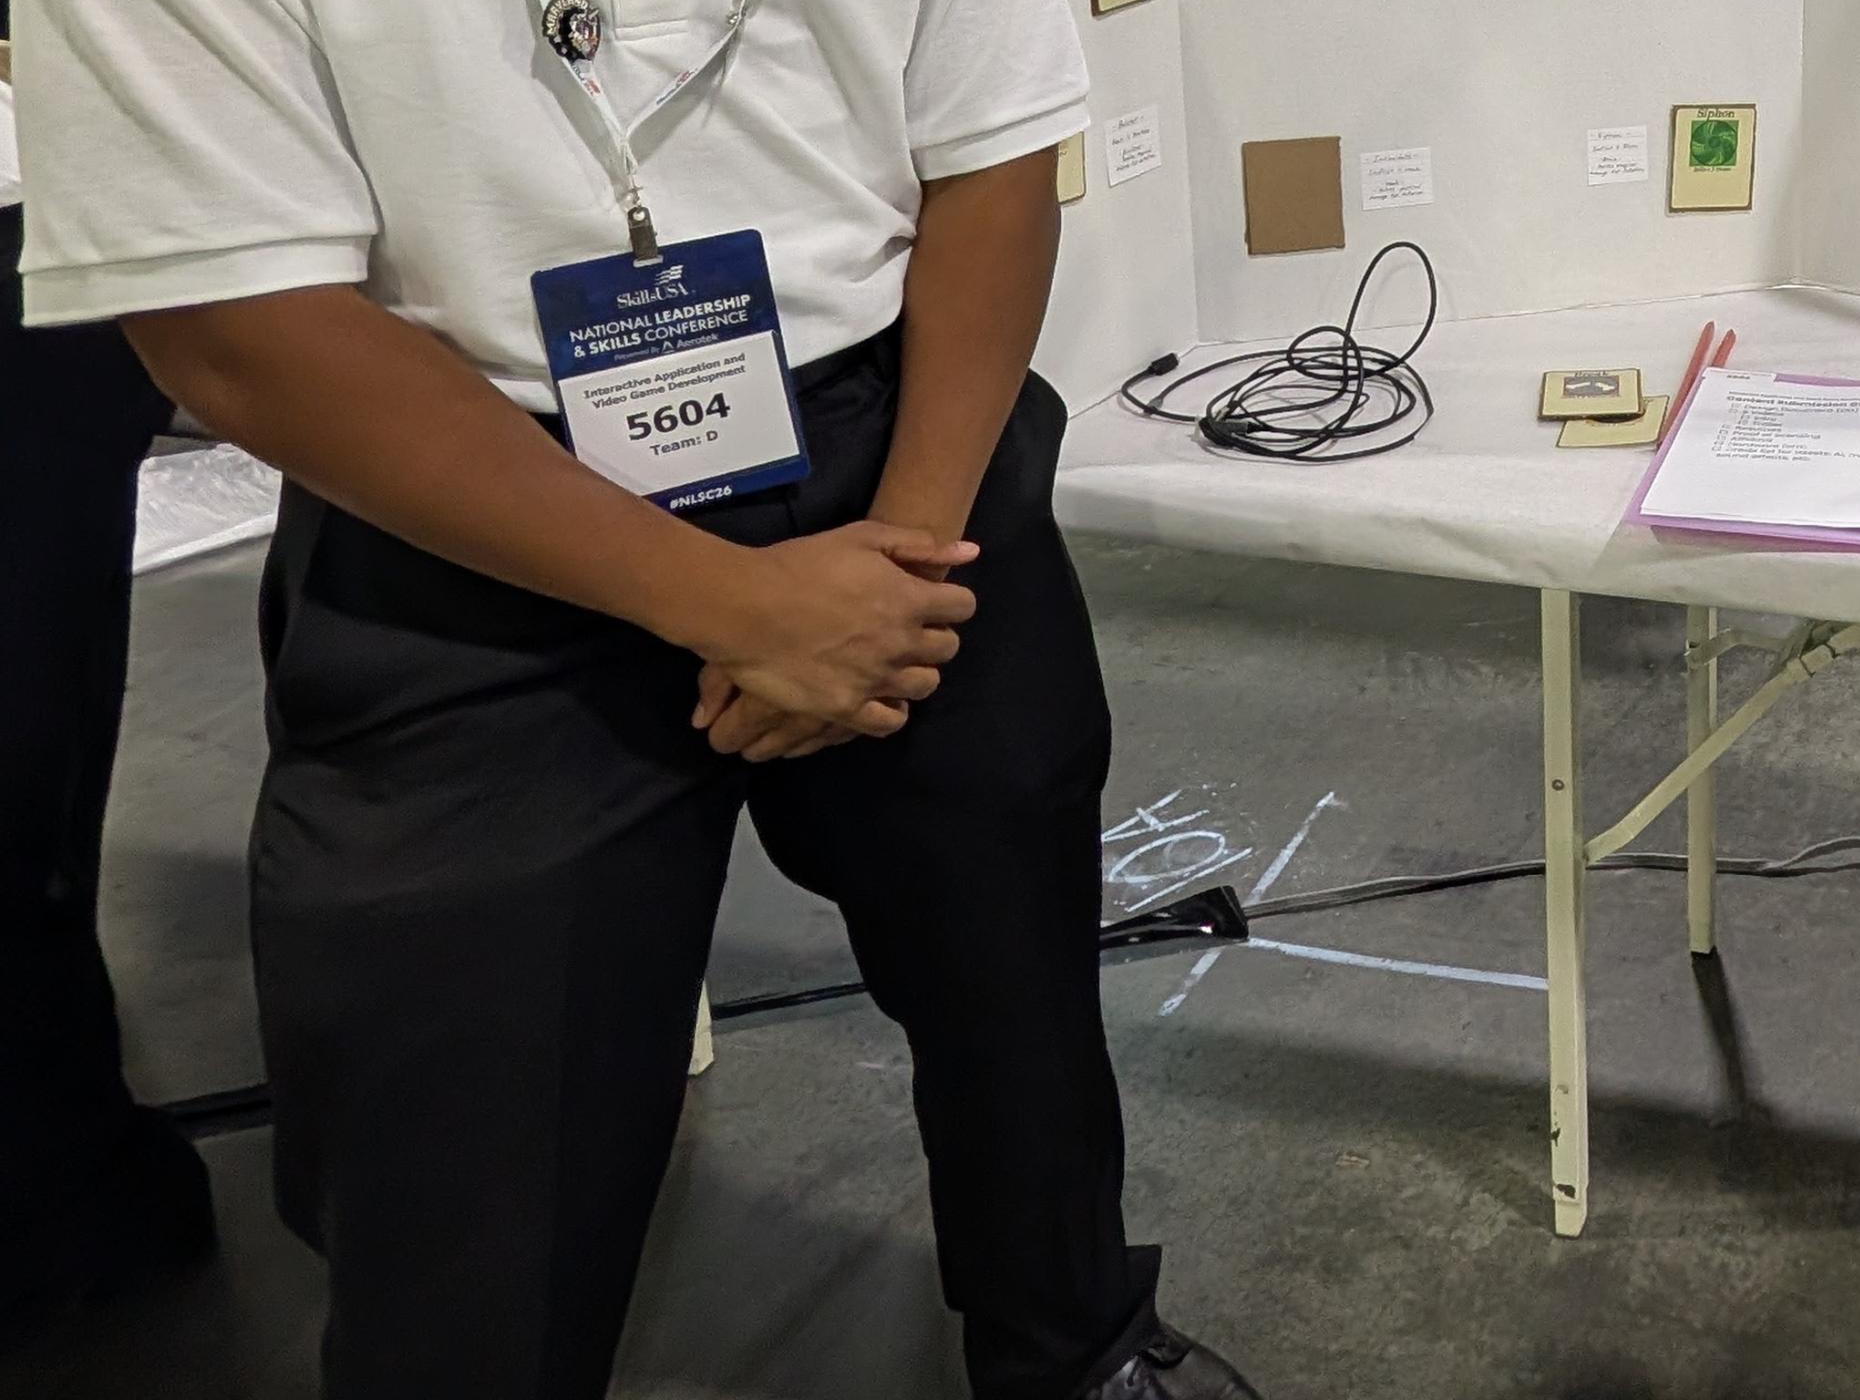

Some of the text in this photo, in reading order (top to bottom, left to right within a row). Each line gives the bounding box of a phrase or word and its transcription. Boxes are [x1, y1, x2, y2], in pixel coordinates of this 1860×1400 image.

[1696, 108, 1736, 122] Siphon
[617, 282, 689, 309] SkillsUSA
[569, 294, 751, 343] NATIONAL LEADERSHIP
[574, 310, 748, 358] & SKILLS CONFERENCE
[584, 353, 746, 399] Interactive Application and
[592, 365, 746, 409] Video Game Development
[626, 393, 731, 441] 5604
[650, 429, 718, 456] Team: D
[670, 485, 732, 510] #NLSC26
